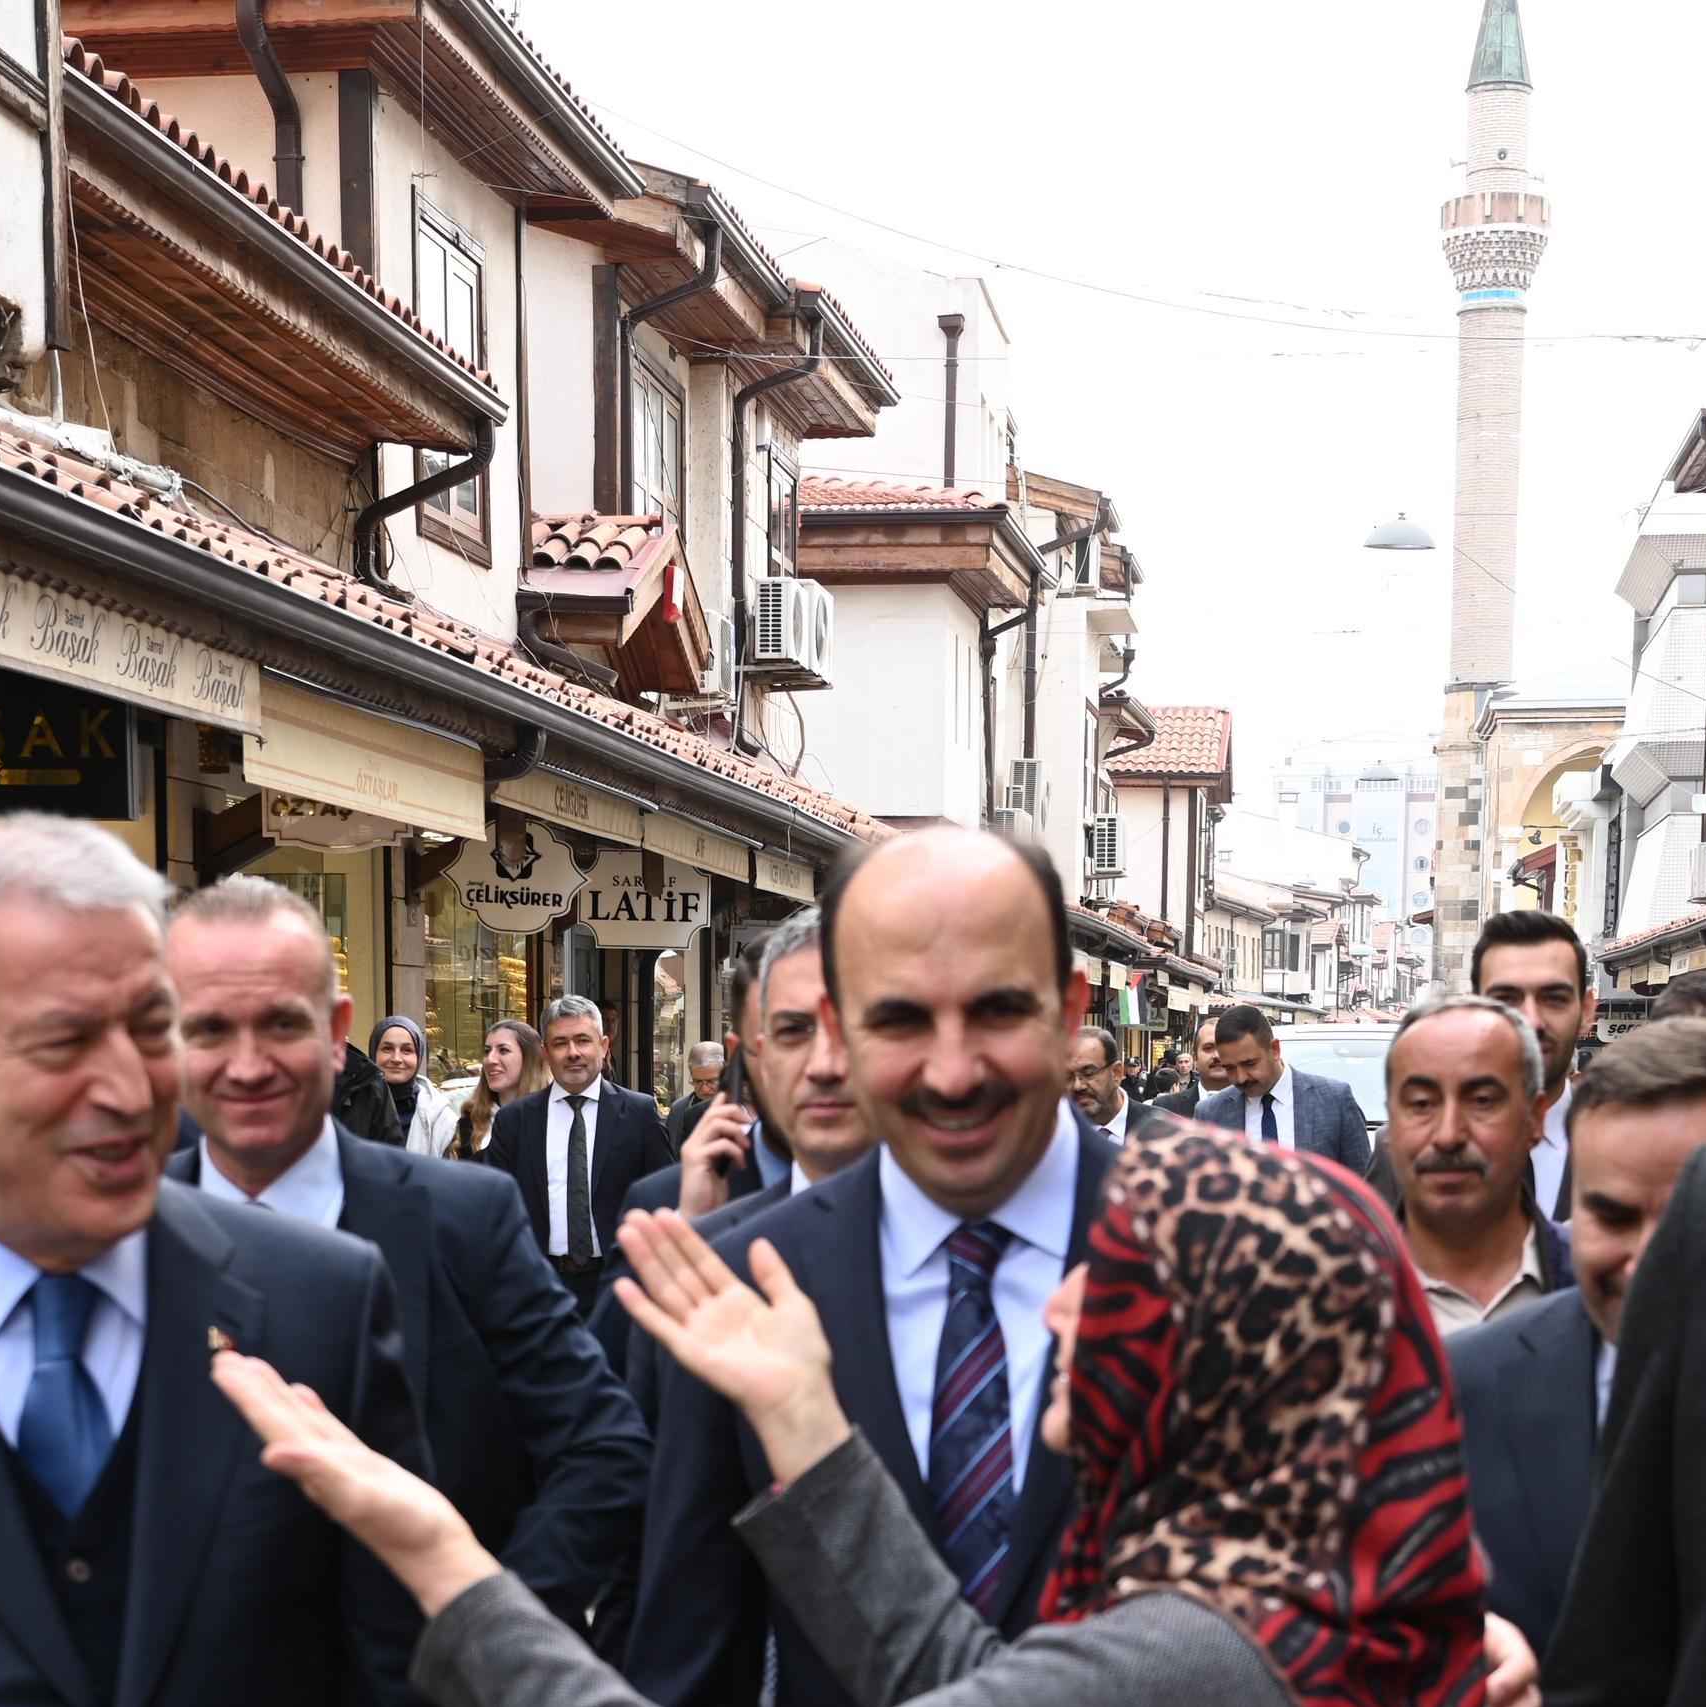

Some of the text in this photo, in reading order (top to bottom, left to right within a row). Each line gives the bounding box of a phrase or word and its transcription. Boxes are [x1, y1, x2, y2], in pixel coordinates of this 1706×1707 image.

[30, 594, 105, 668] Başak
[64, 608, 85, 629] Sarraf
[116, 623, 182, 692] Başak
[192, 648, 251, 713] Başak
[466, 885, 563, 909] ÇELİKSÜRER
[588, 891, 700, 922] LATİF
